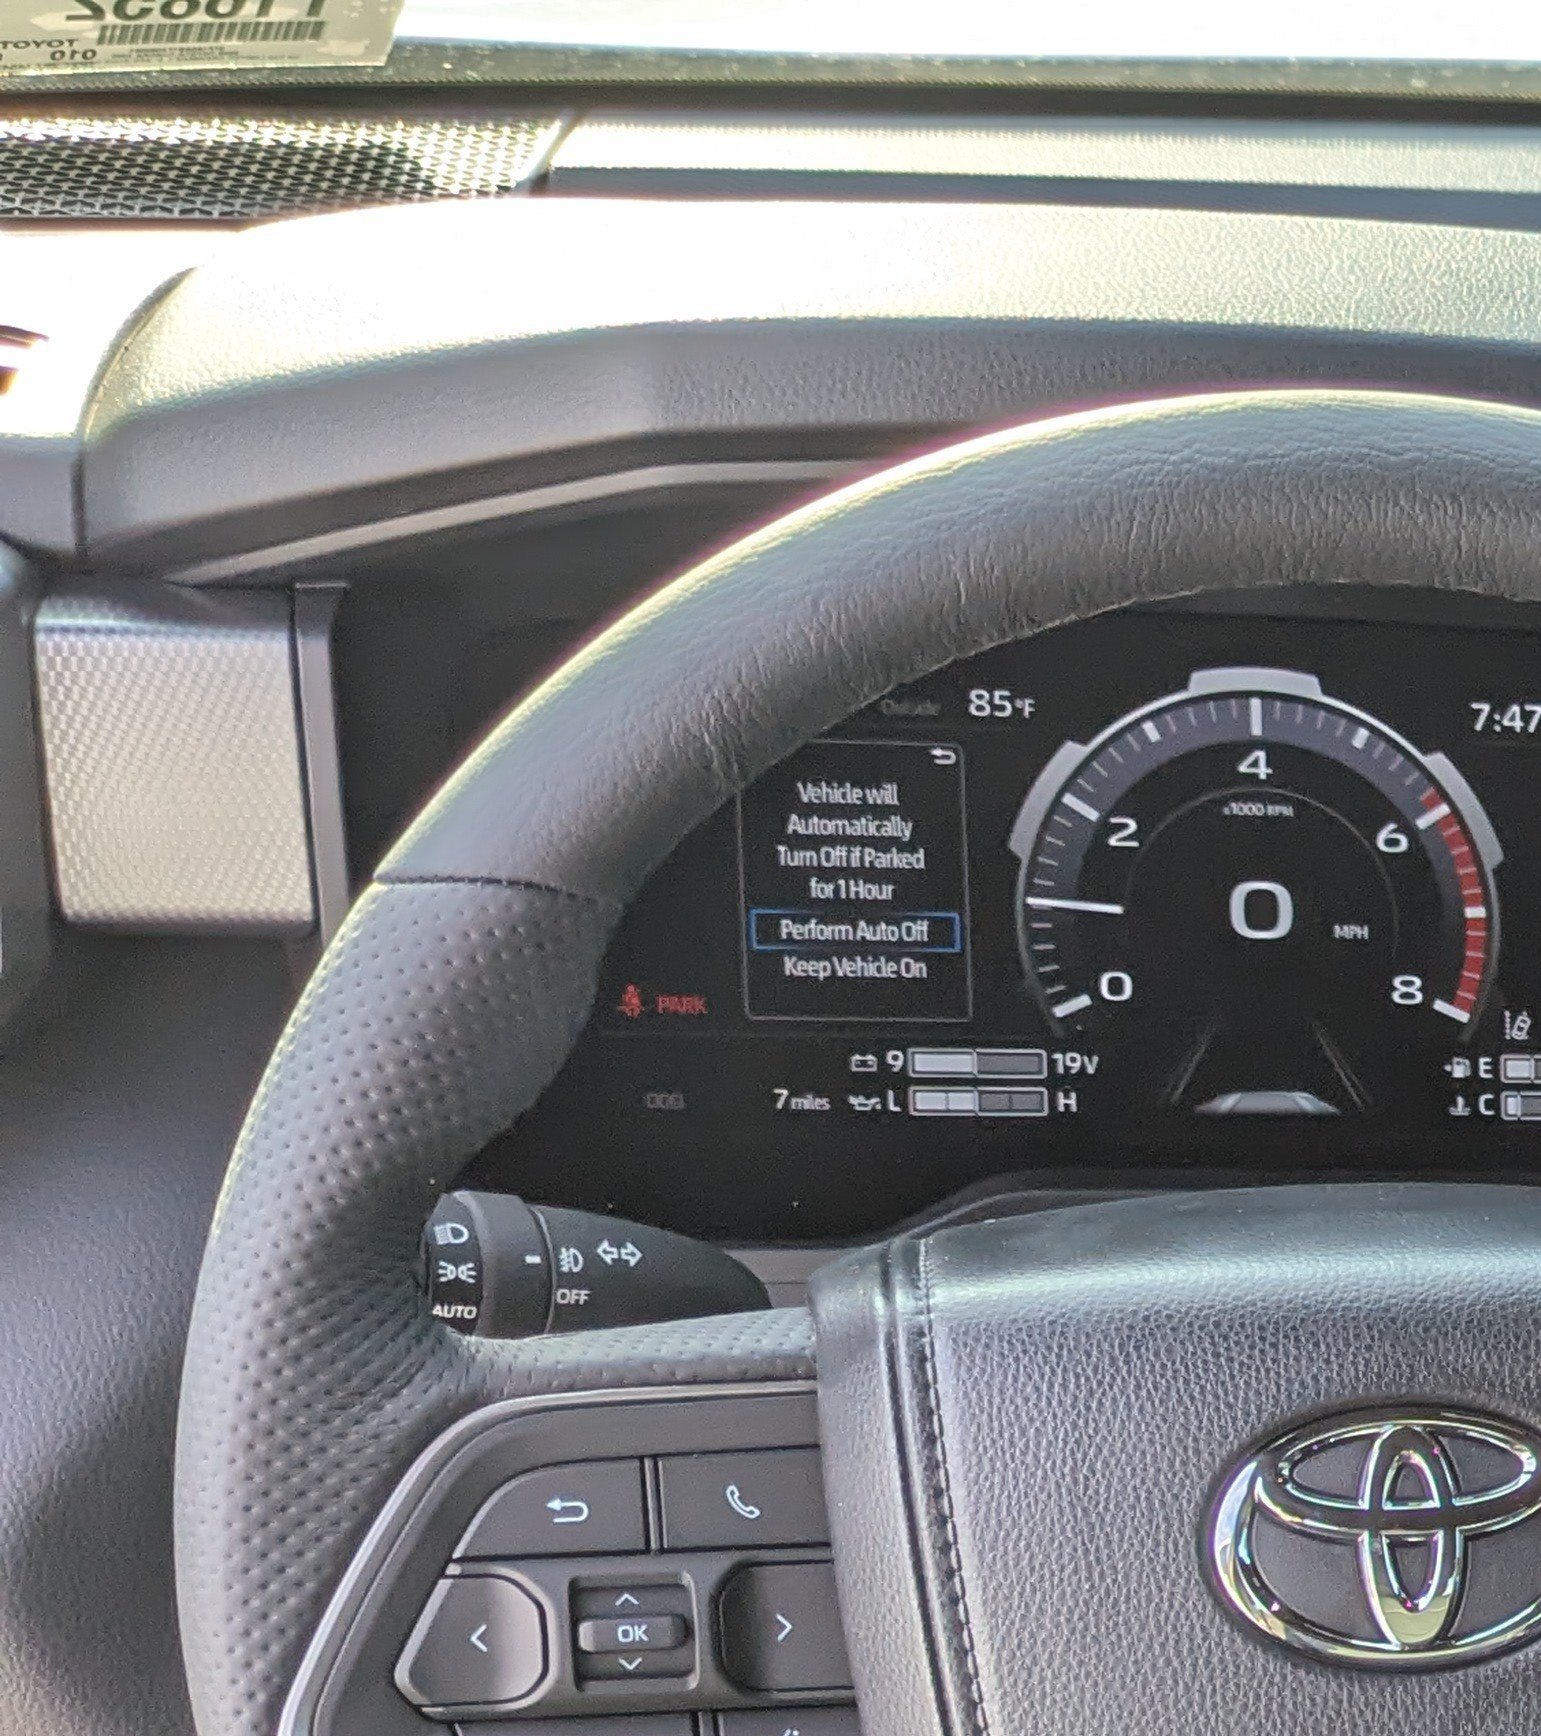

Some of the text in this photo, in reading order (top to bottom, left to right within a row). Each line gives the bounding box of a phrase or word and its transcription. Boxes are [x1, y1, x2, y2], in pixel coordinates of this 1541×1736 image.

[1238, 750, 1272, 780] 4
[797, 783, 899, 805] Vehicle will
[787, 815, 913, 841] Automatically
[1109, 817, 1139, 848] 2
[1376, 824, 1409, 853] 6
[778, 846, 925, 870] Turn Off if Parked
[809, 878, 836, 901] for
[849, 878, 895, 901] Hour
[1229, 880, 1294, 940] 0
[780, 919, 929, 942] Perform Auto Off
[1334, 924, 1369, 941] MPH
[784, 957, 927, 981] Keep Vehicle On
[1100, 972, 1134, 1002] 0
[1391, 974, 1423, 1005] 8
[886, 1052, 904, 1073] 9
[1479, 1059, 1493, 1079] E
[773, 1090, 831, 1112] 7 miles
[888, 1091, 901, 1111] L
[1057, 1092, 1077, 1112] H
[1479, 1097, 1494, 1116] C
[556, 1289, 590, 1306] OFF
[432, 1304, 477, 1319] AUTO
[617, 1625, 649, 1643] OK
